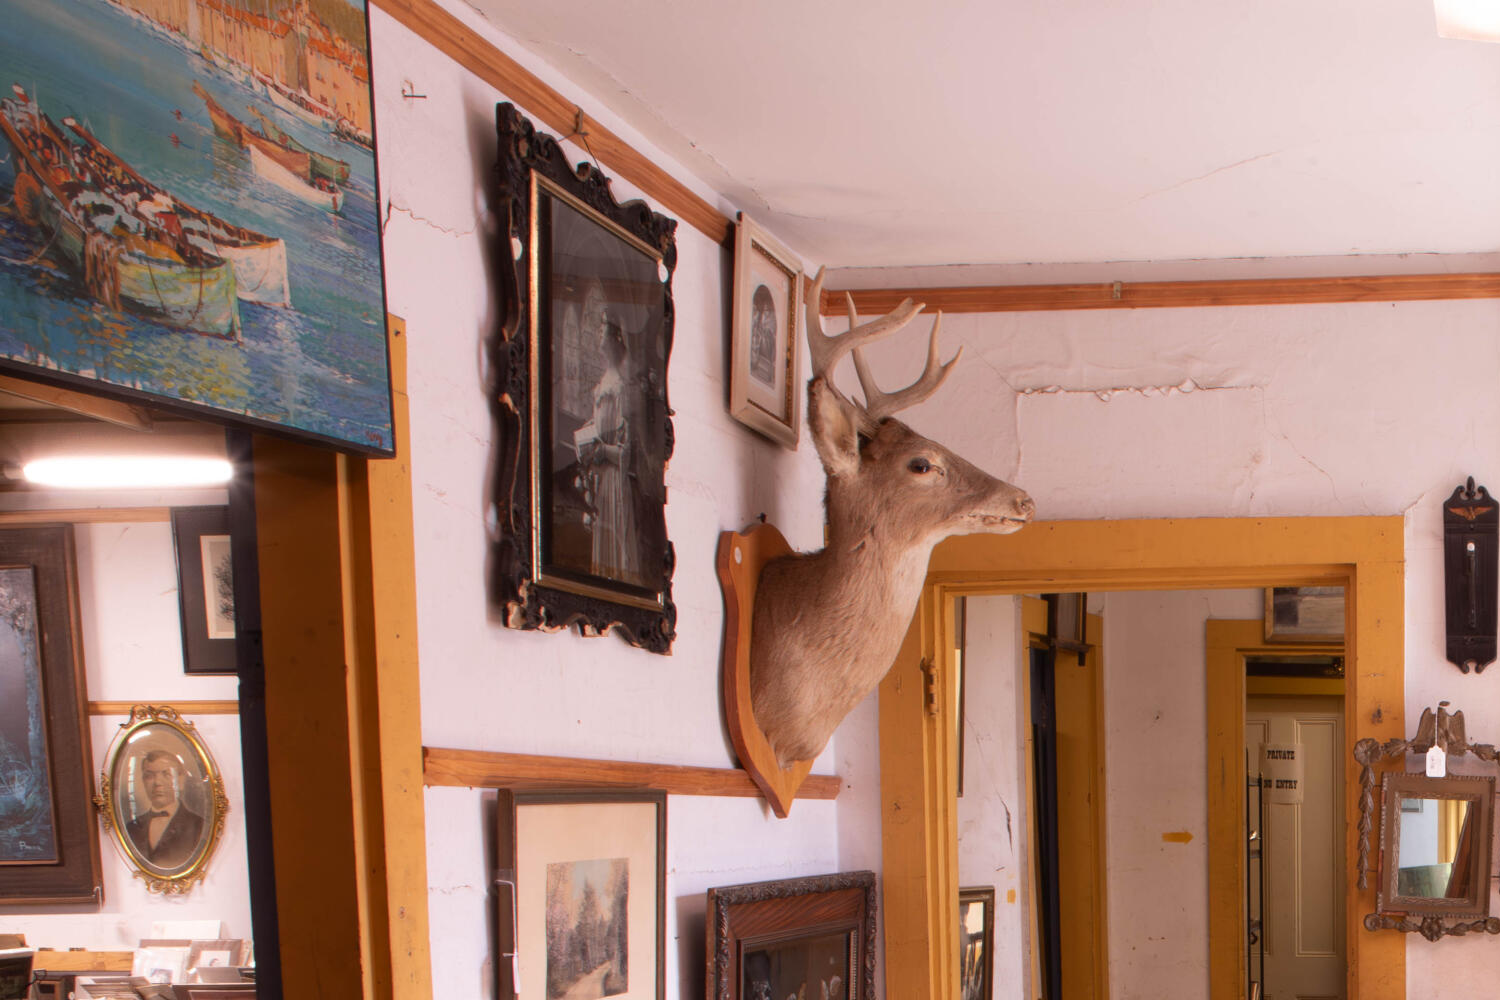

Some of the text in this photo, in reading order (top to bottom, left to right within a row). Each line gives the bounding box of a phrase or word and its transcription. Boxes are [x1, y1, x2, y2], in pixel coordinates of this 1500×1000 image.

[1266, 750, 1295, 760] PRIVATE
[1263, 779, 1298, 789] NO ENTRY
